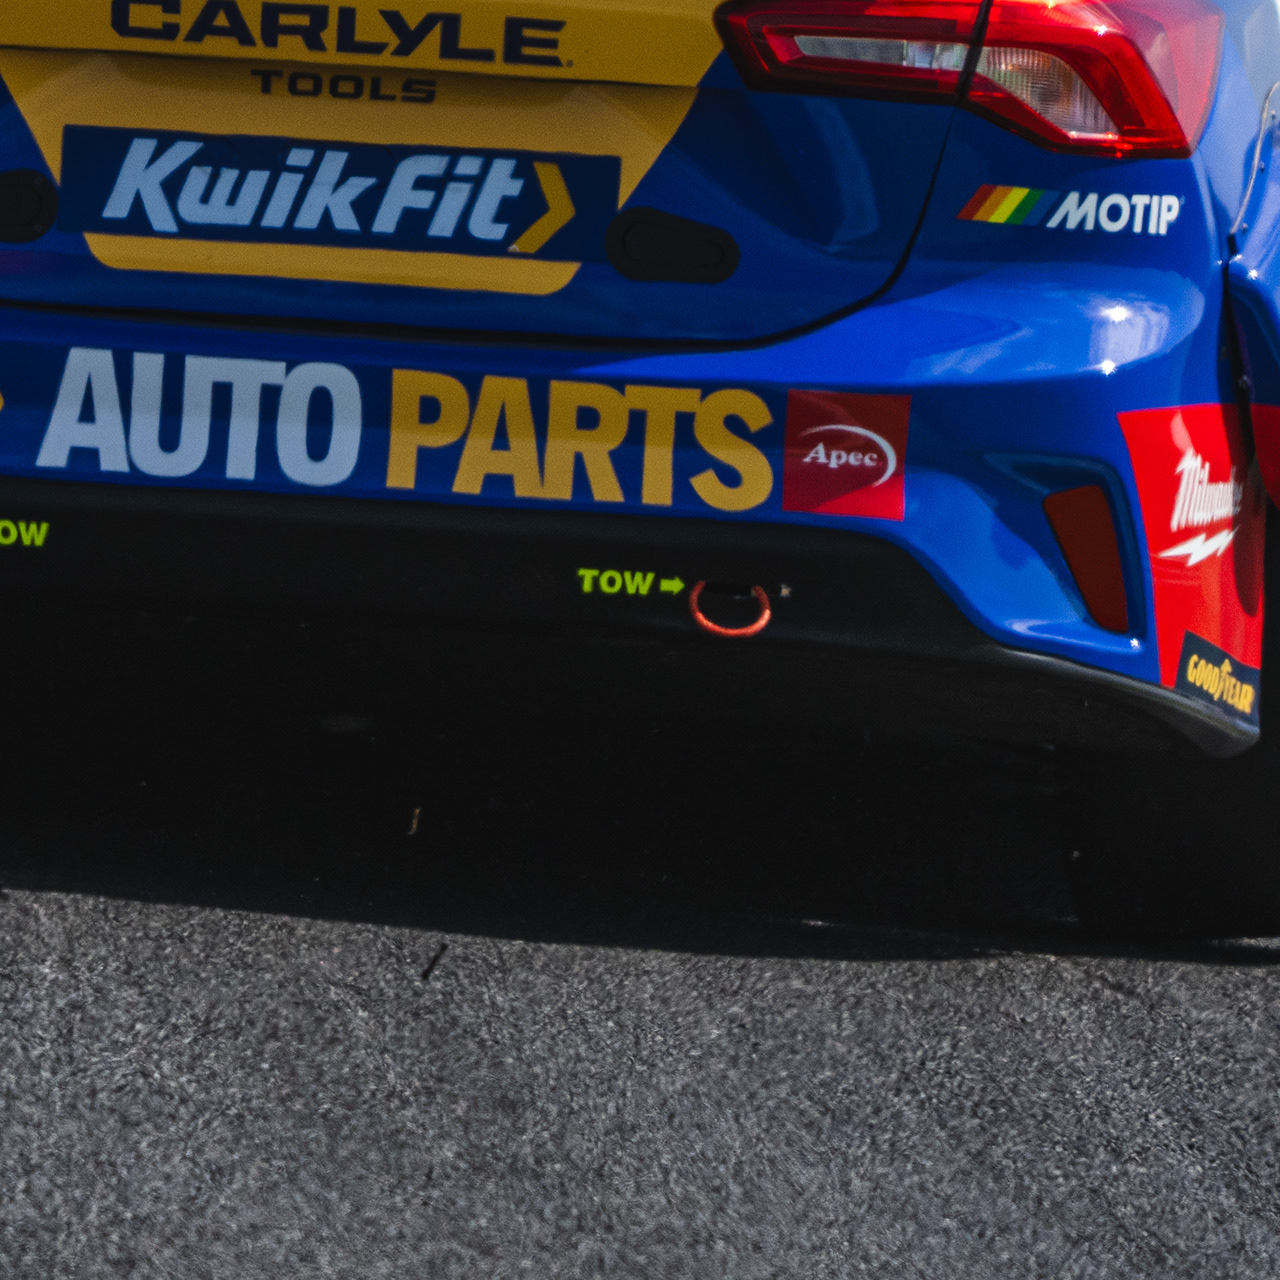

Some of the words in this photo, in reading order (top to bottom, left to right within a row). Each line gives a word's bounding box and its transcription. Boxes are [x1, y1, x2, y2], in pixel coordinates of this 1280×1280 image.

[250, 68, 438, 105] TOOLS
[1045, 191, 1180, 236] MOTIP
[34, 346, 363, 487] AUTO
[385, 367, 776, 514] PARTS
[802, 442, 878, 468] Apec
[576, 567, 655, 598] TOW
[1186, 653, 1256, 715] GOODYEAR
